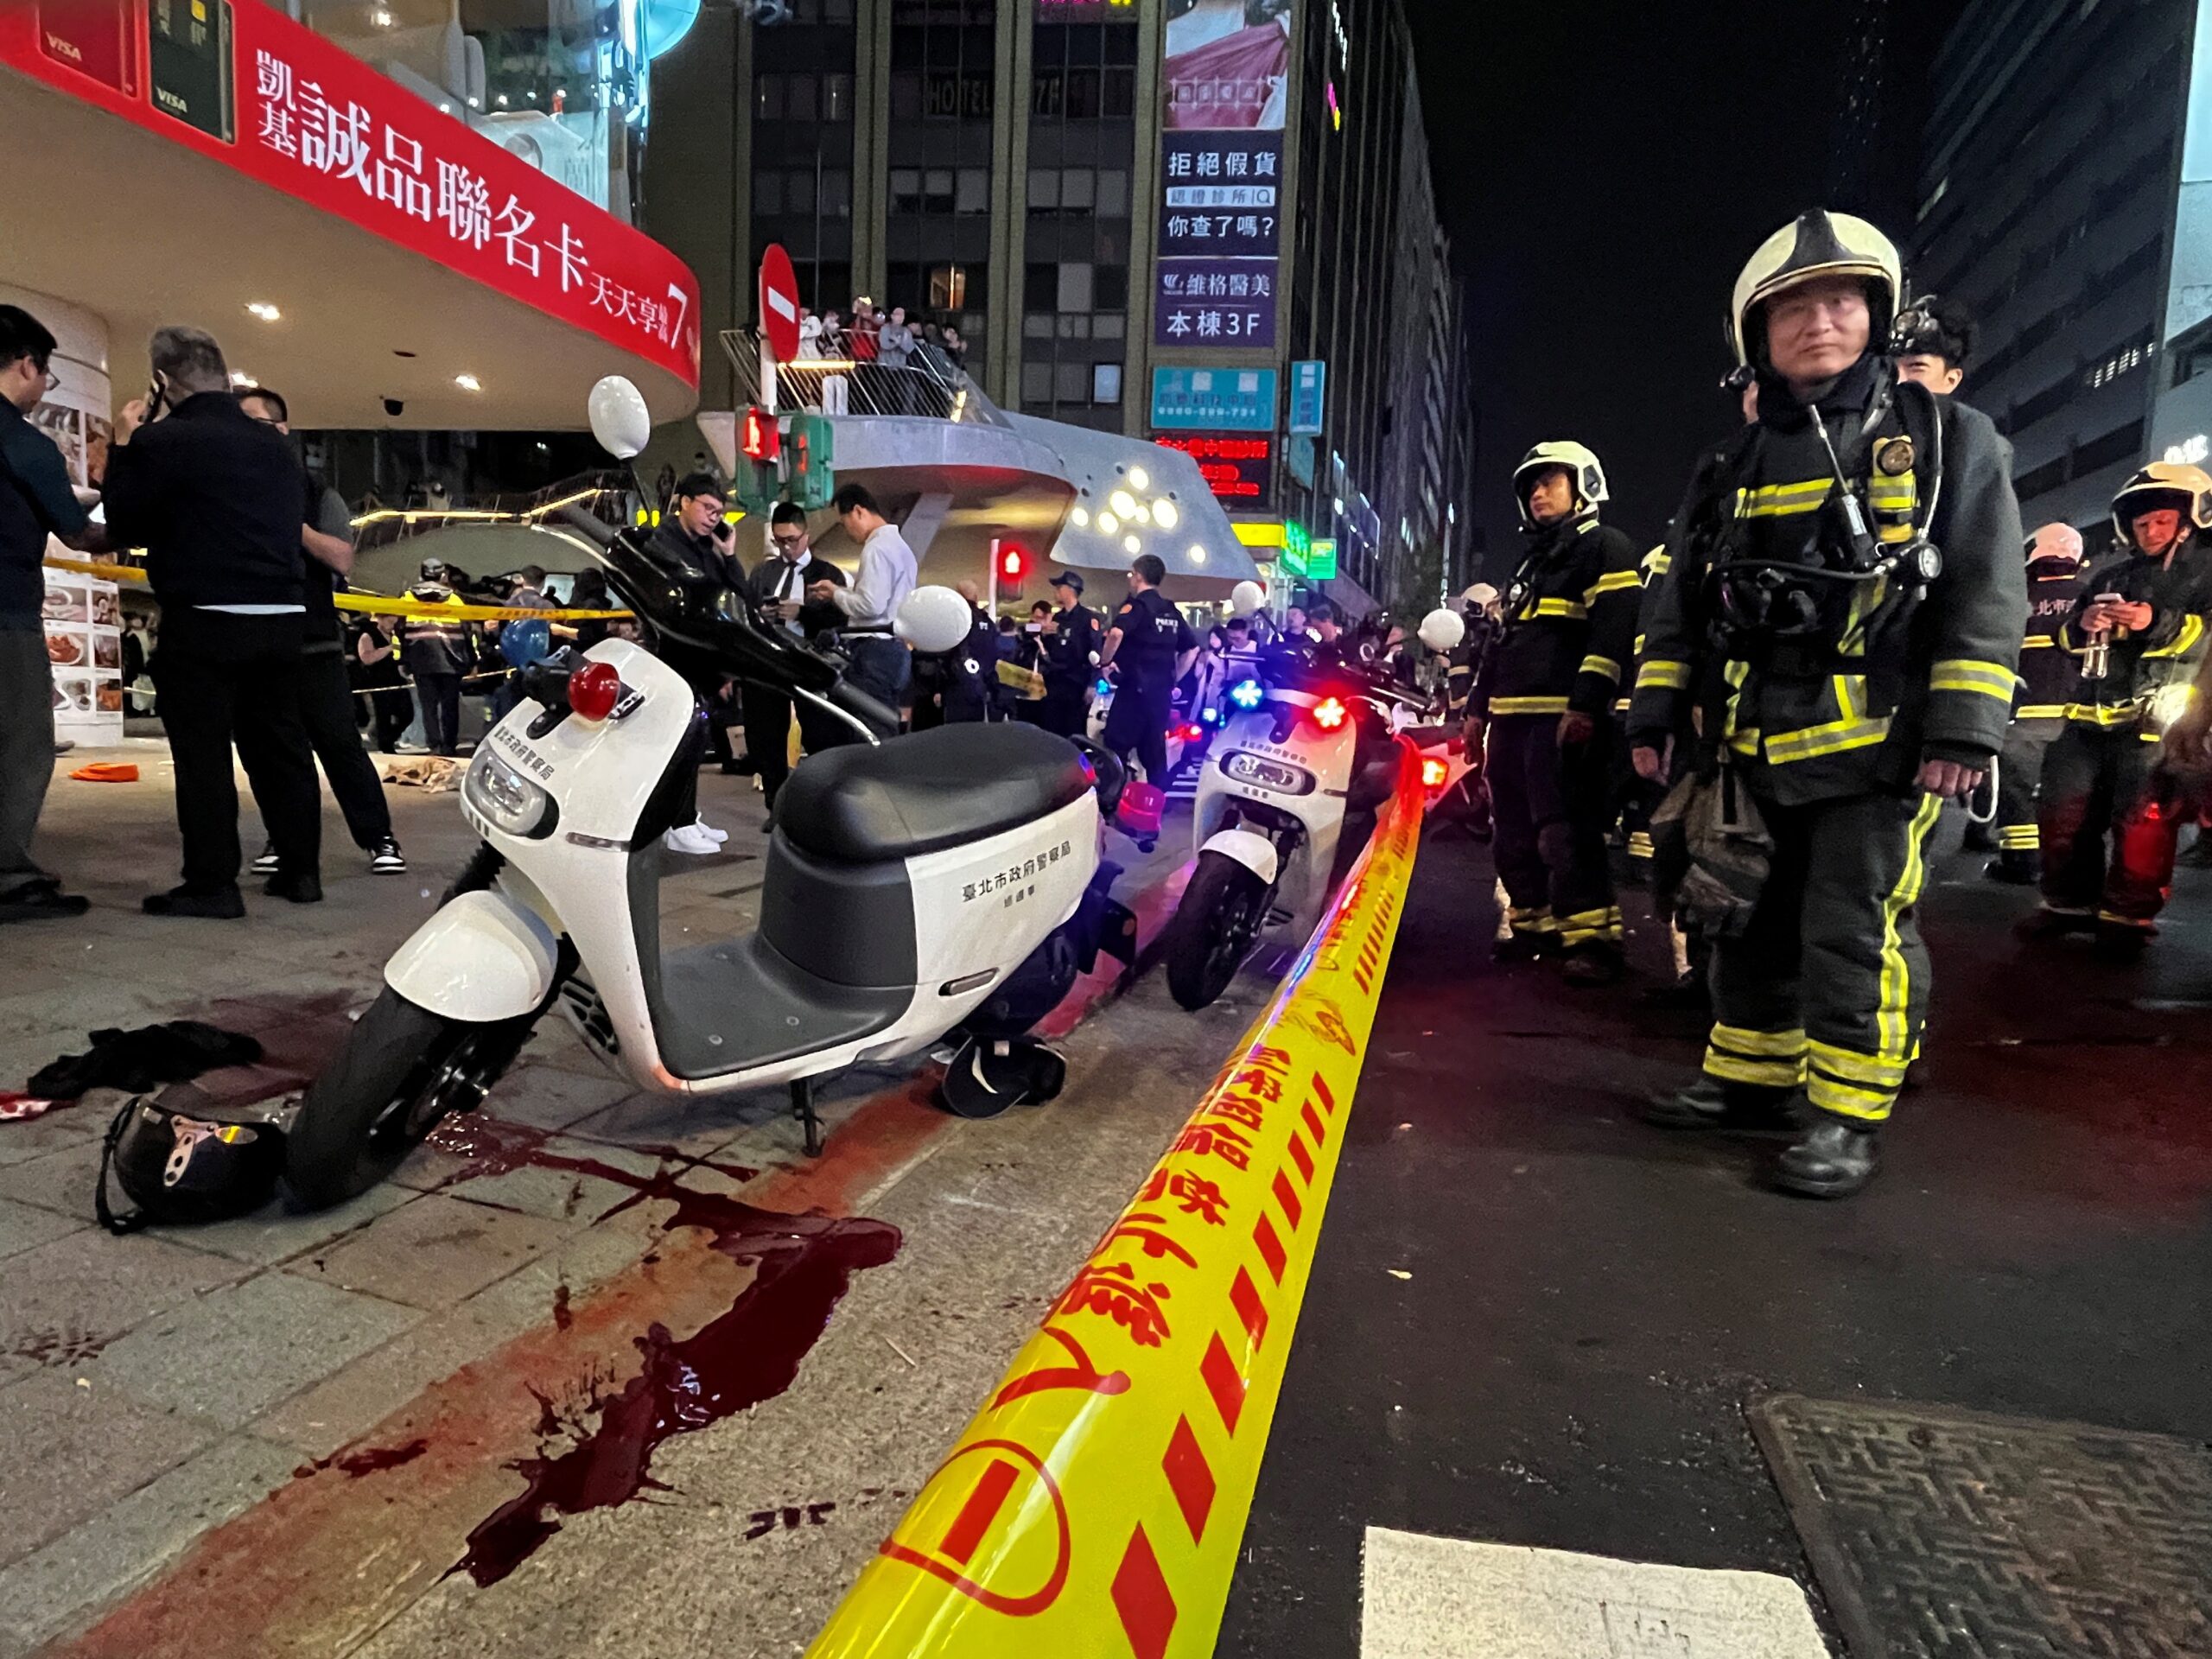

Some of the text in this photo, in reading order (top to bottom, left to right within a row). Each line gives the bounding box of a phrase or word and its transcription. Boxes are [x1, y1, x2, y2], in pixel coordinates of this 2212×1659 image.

[46, 31, 82, 61] VISA
[156, 86, 188, 113] VISA
[1168, 151, 1276, 177] 拒絕假貨
[1185, 274, 1270, 297] 維格醫美
[494, 726, 555, 780] 市政府警察局
[963, 841, 1071, 902] 臺北市政府警察局
